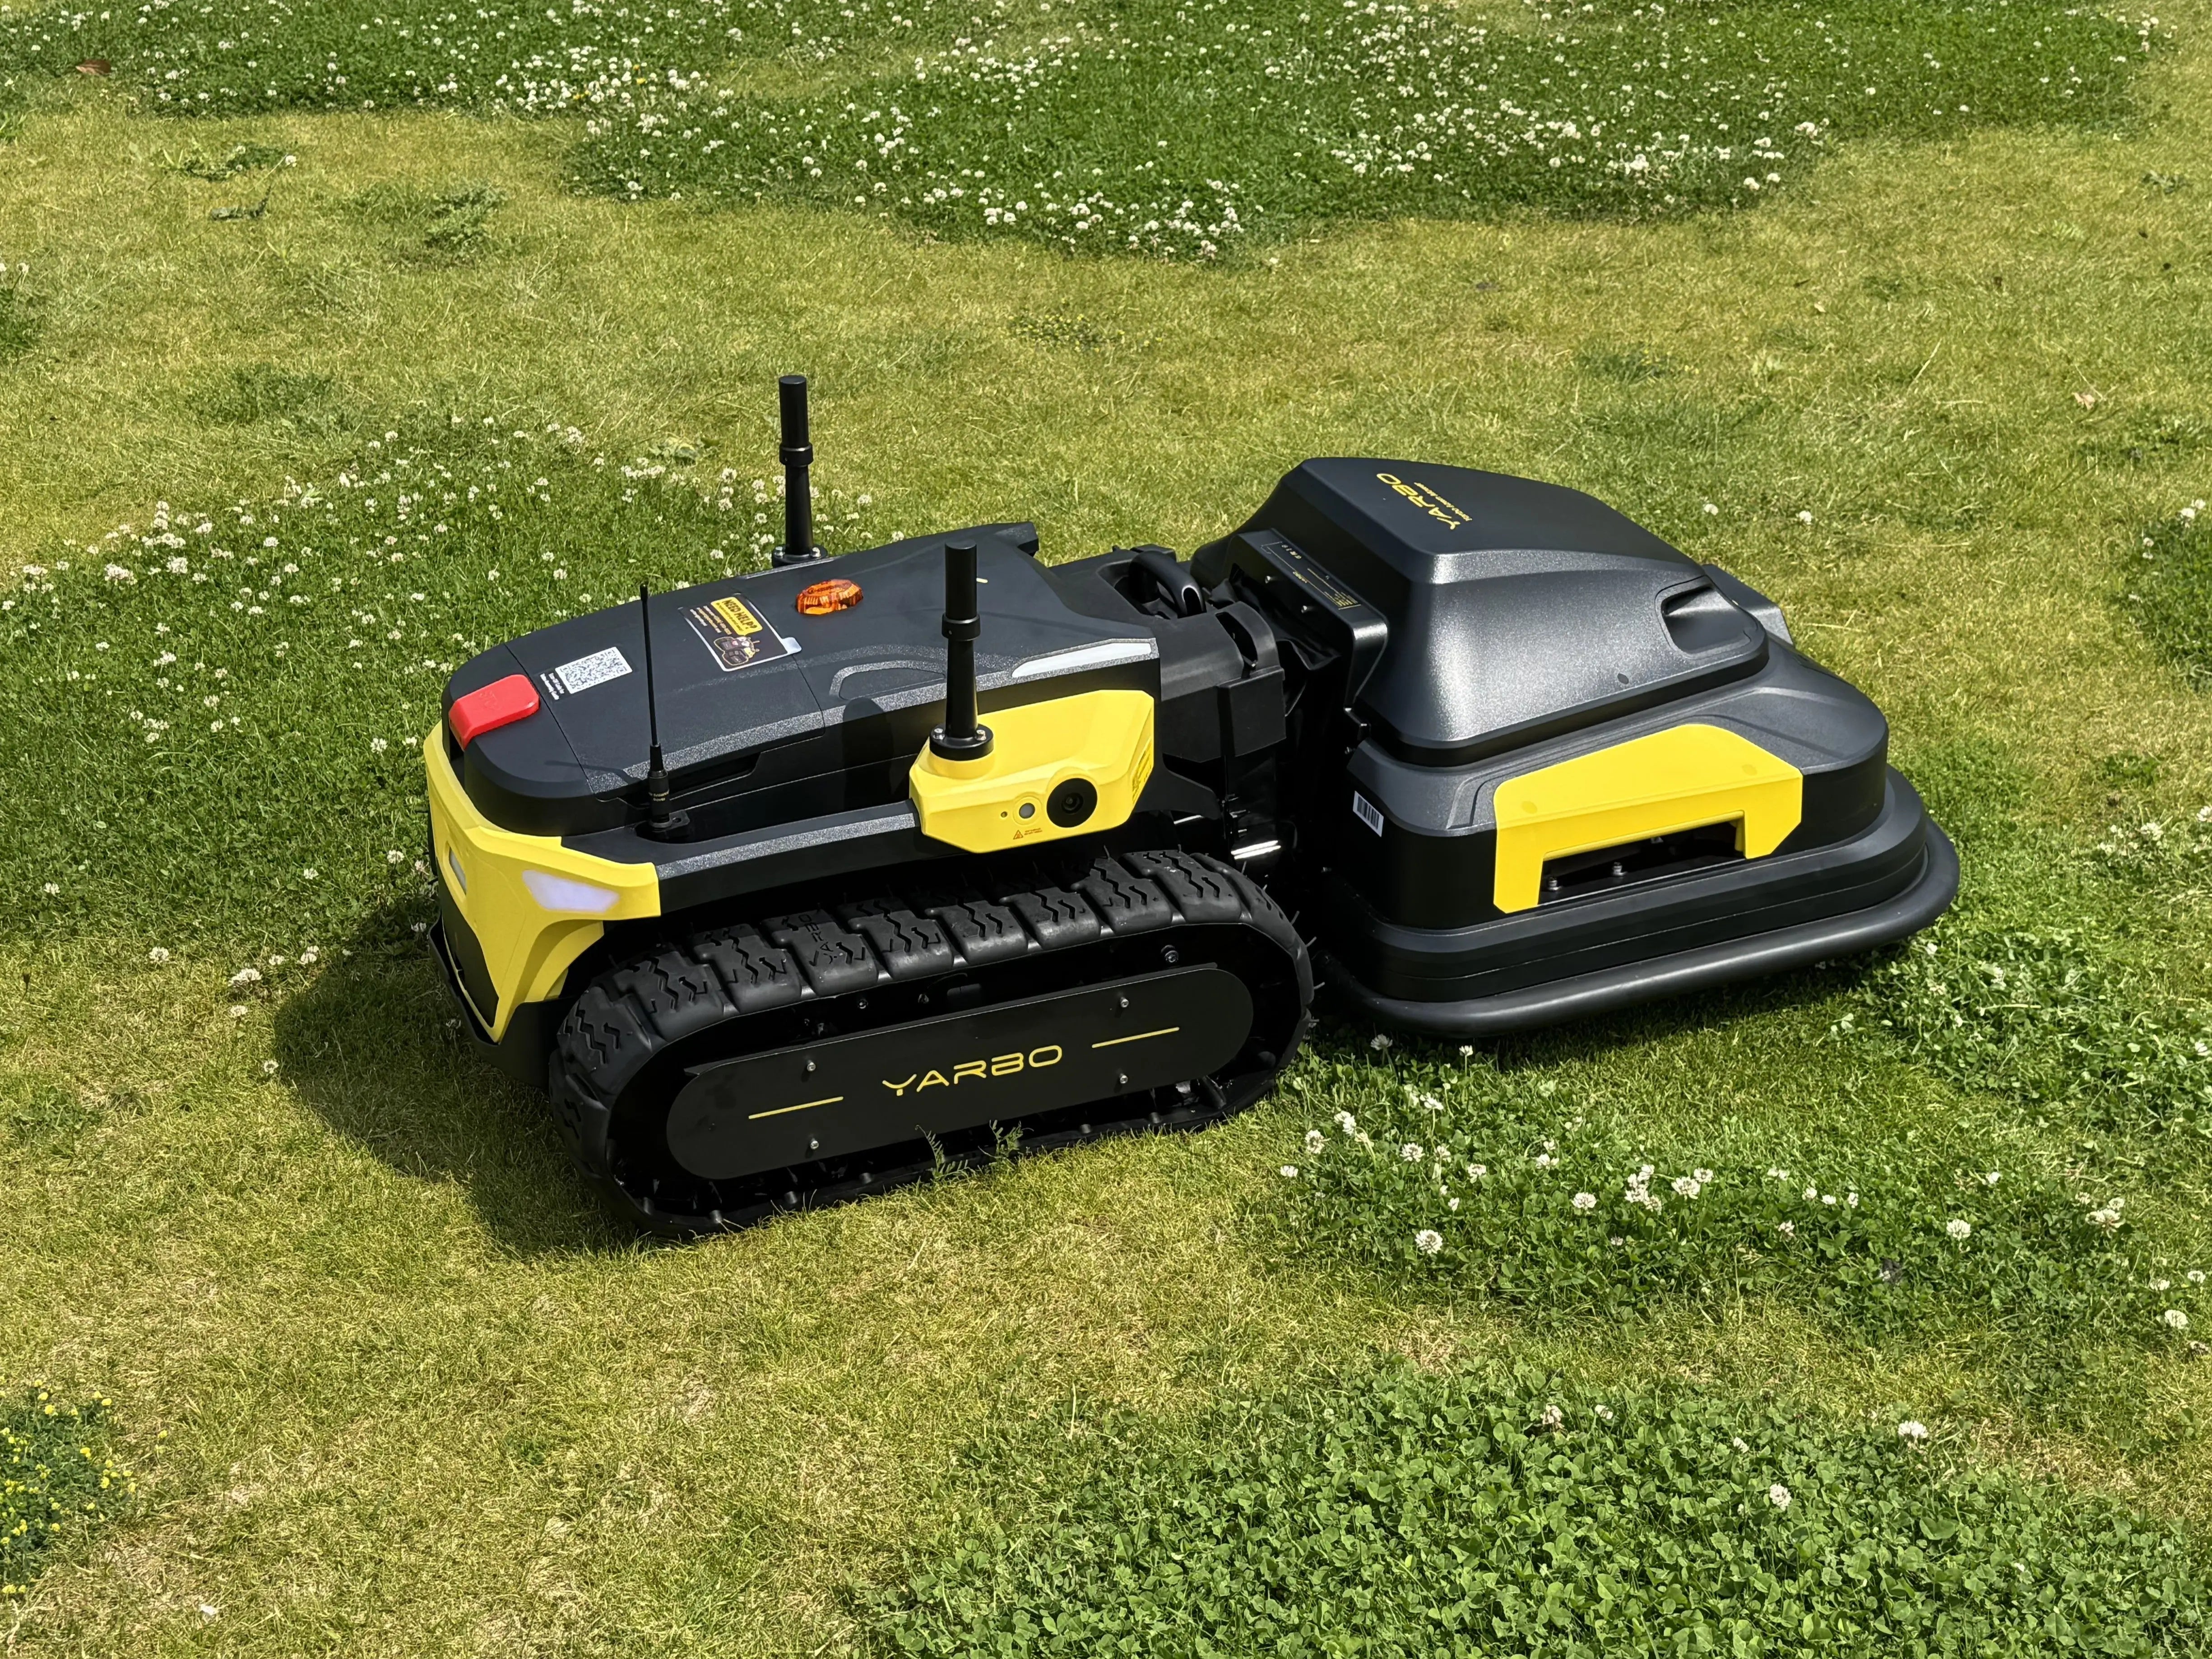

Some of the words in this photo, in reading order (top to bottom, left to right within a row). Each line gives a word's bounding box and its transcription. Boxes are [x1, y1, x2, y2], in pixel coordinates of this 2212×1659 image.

[1376, 473, 1461, 530] YARBO
[722, 599, 742, 613] NEED
[734, 611, 757, 629] HELP?
[882, 1045, 1062, 1097] YARBO
